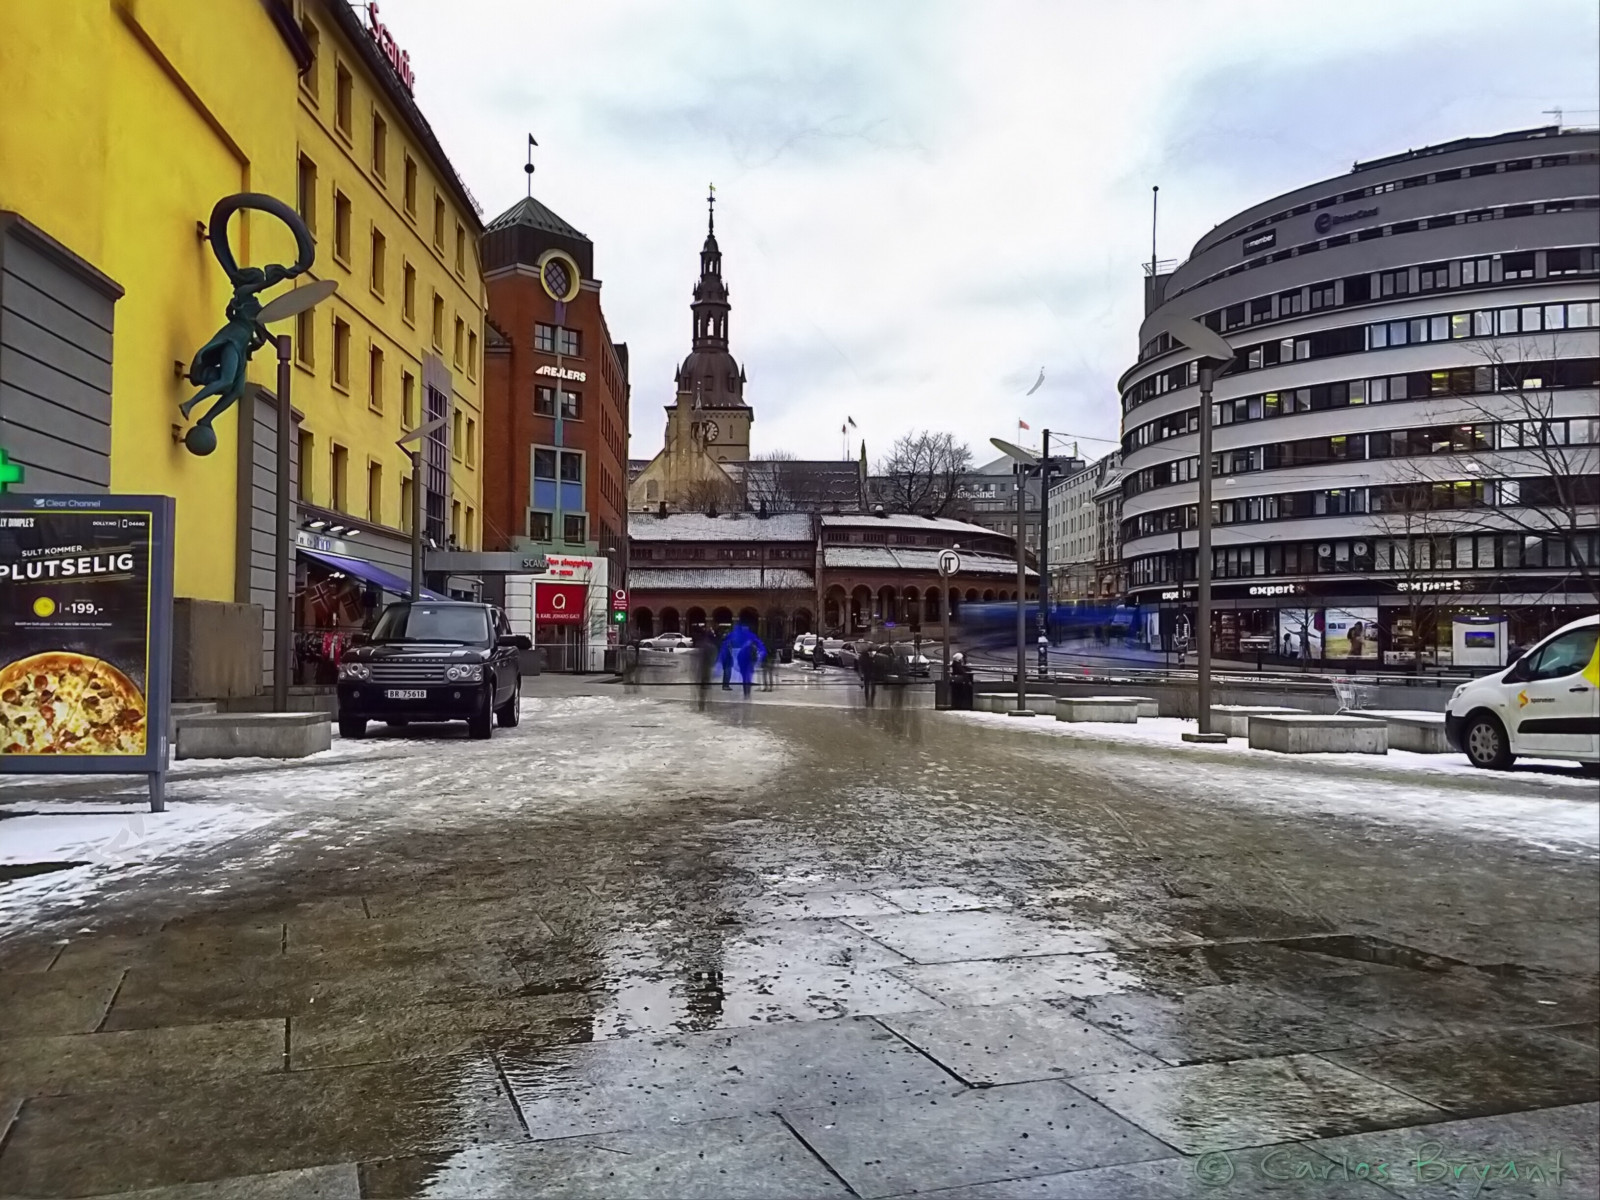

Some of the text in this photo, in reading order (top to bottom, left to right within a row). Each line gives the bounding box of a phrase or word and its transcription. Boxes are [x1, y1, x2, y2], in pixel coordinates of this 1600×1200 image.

[369, 2, 416, 99] Scandic
[46, 499, 101, 508] Clear Channel
[22, 545, 83, 557] SULT KOMMER
[0, 553, 134, 580] PLUTSELIG
[1249, 584, 1295, 597] expert
[389, 690, 425, 698] BR 75618
